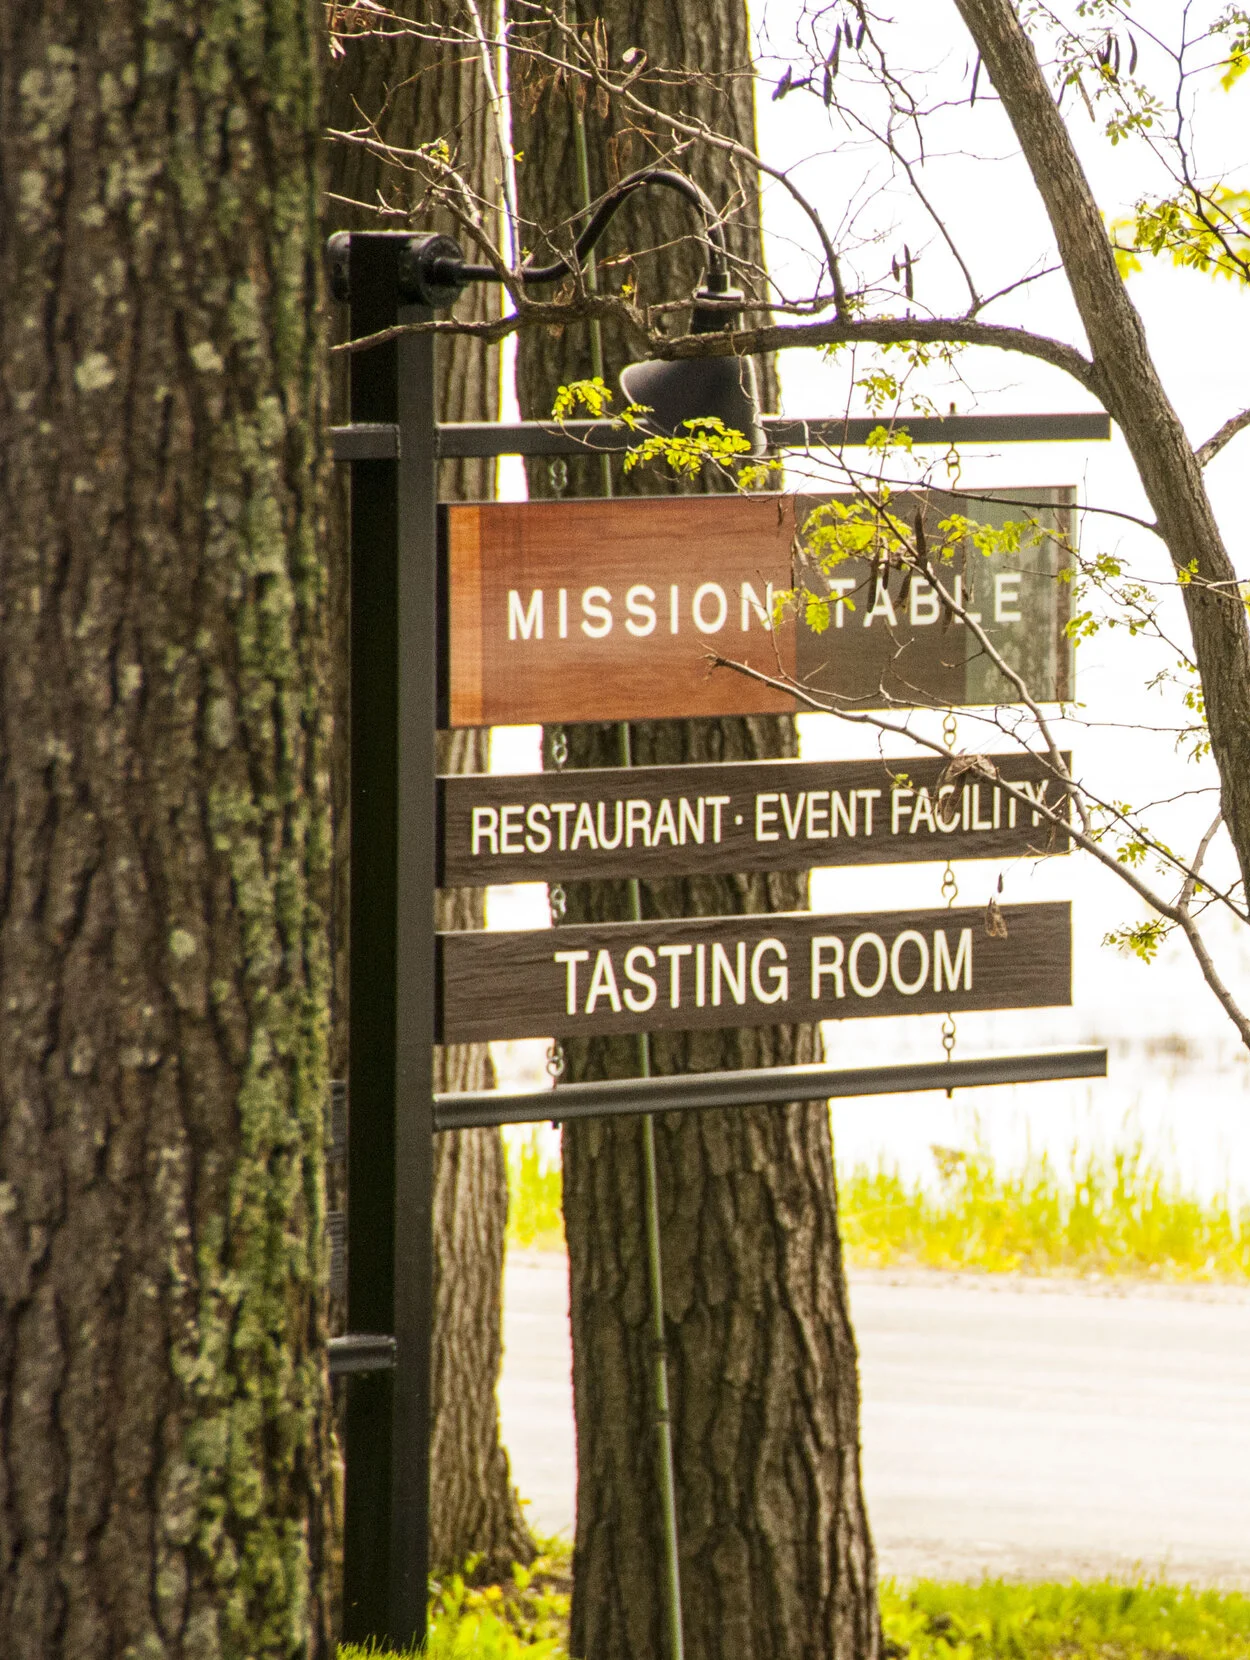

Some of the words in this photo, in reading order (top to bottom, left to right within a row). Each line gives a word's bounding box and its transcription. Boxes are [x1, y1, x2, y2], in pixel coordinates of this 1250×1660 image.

[506, 579, 775, 641] MISSION
[827, 573, 1022, 629] TABLE
[471, 794, 731, 855] RESTAURANT
[754, 787, 882, 842] EVENT
[891, 778, 1049, 835] FACILITY
[554, 938, 789, 1016] TASTING
[809, 927, 974, 1001] ROOM
